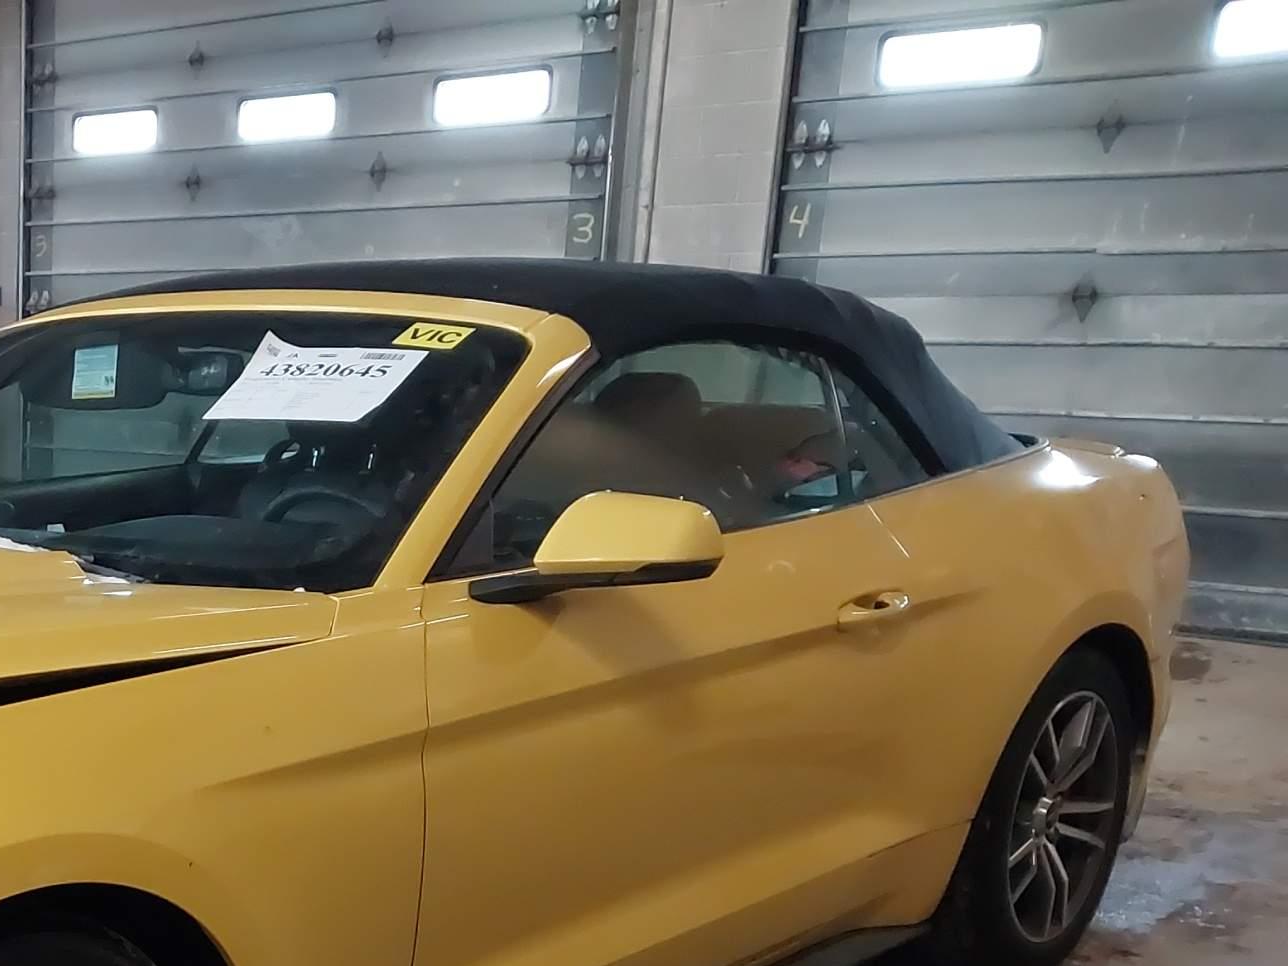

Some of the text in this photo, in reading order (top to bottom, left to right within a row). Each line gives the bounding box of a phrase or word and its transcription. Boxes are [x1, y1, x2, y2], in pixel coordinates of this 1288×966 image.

[572, 212, 595, 244] 3
[788, 202, 812, 239] 4
[410, 327, 463, 344] VIC
[259, 362, 393, 378] 43820645
